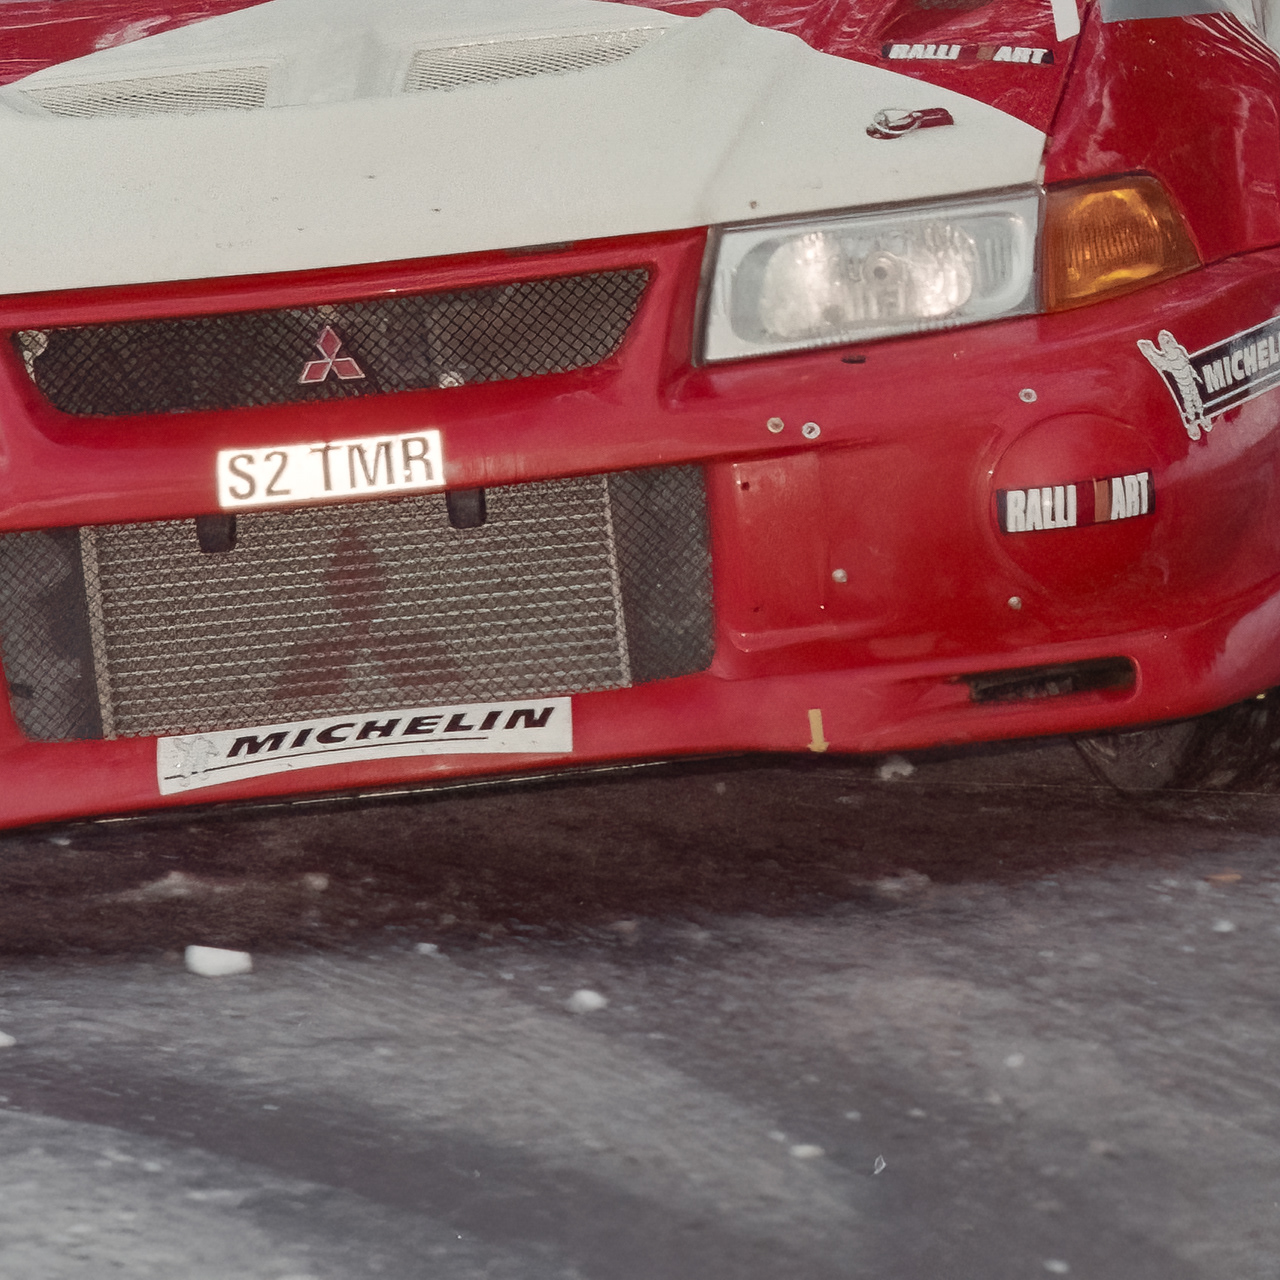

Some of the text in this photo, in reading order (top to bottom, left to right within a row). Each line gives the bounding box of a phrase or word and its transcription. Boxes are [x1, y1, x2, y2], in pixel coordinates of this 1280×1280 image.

[228, 436, 434, 500] S2 TMR
[1006, 472, 1149, 533] RALLI ART
[226, 706, 555, 760] MICHELIN
